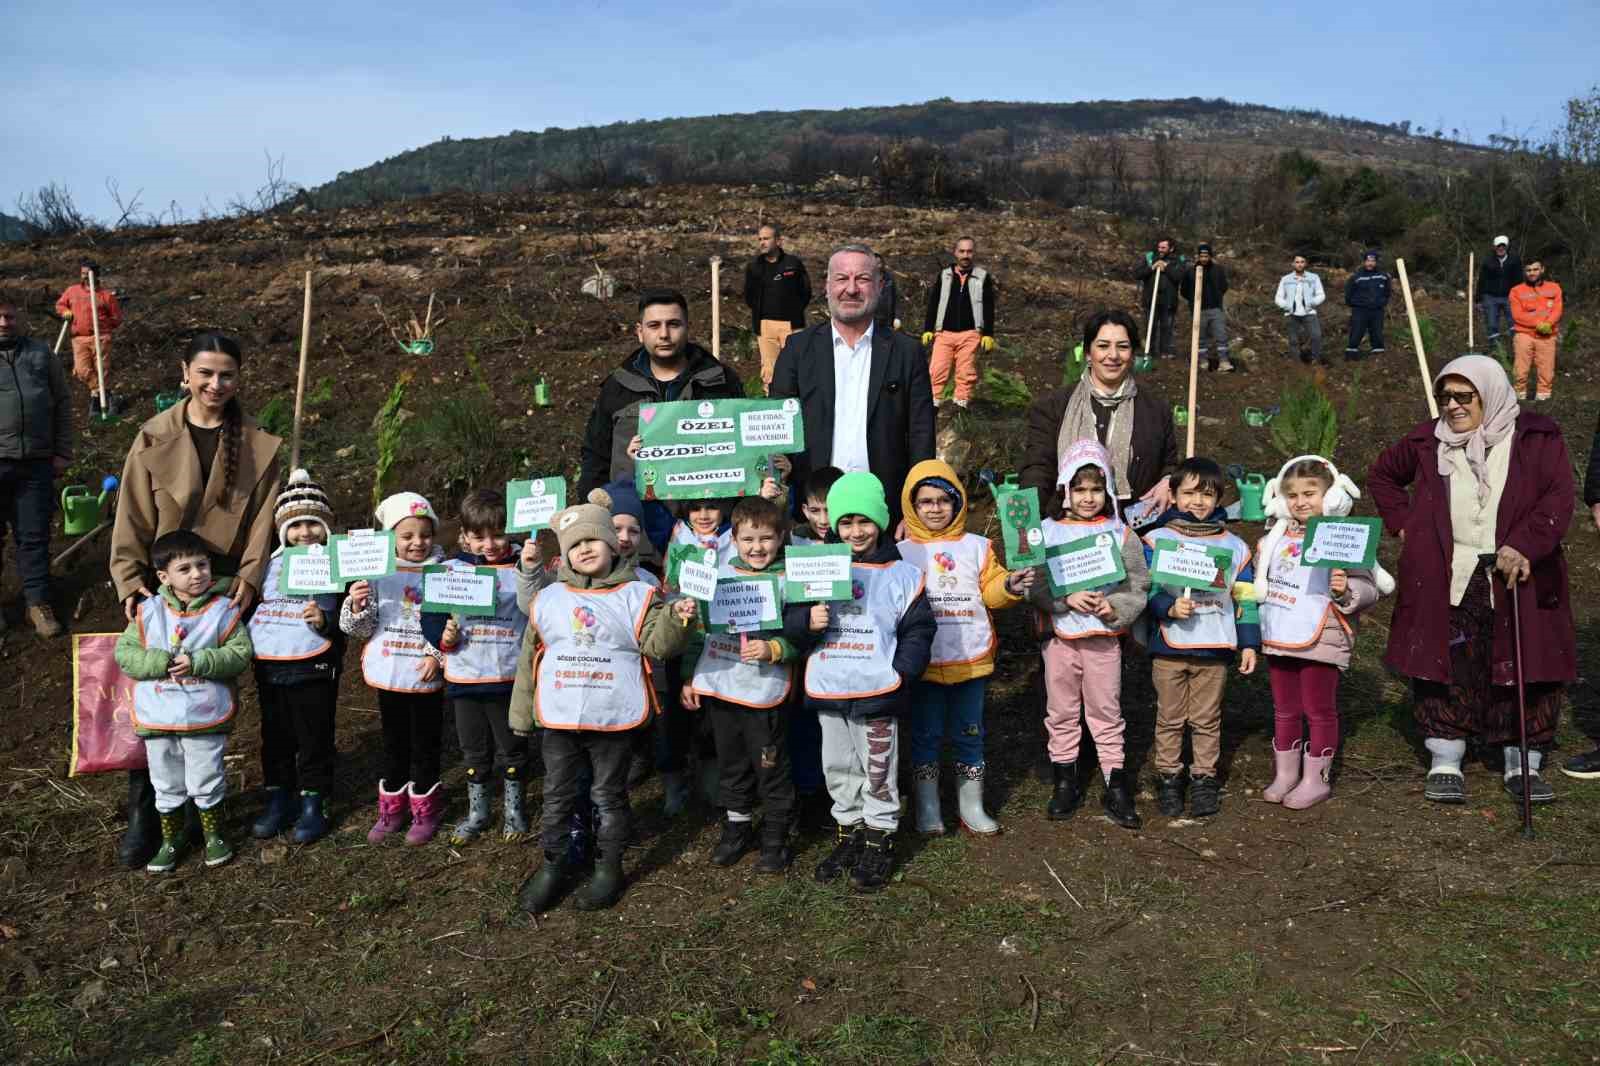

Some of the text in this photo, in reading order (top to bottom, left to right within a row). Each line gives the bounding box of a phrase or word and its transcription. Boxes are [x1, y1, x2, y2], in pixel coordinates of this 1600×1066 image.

[681, 420, 735, 431] ÖZEL
[636, 446, 704, 459] GÖZDE
[668, 471, 742, 482] ANAOKULU
[729, 609, 757, 618] ORMAN
